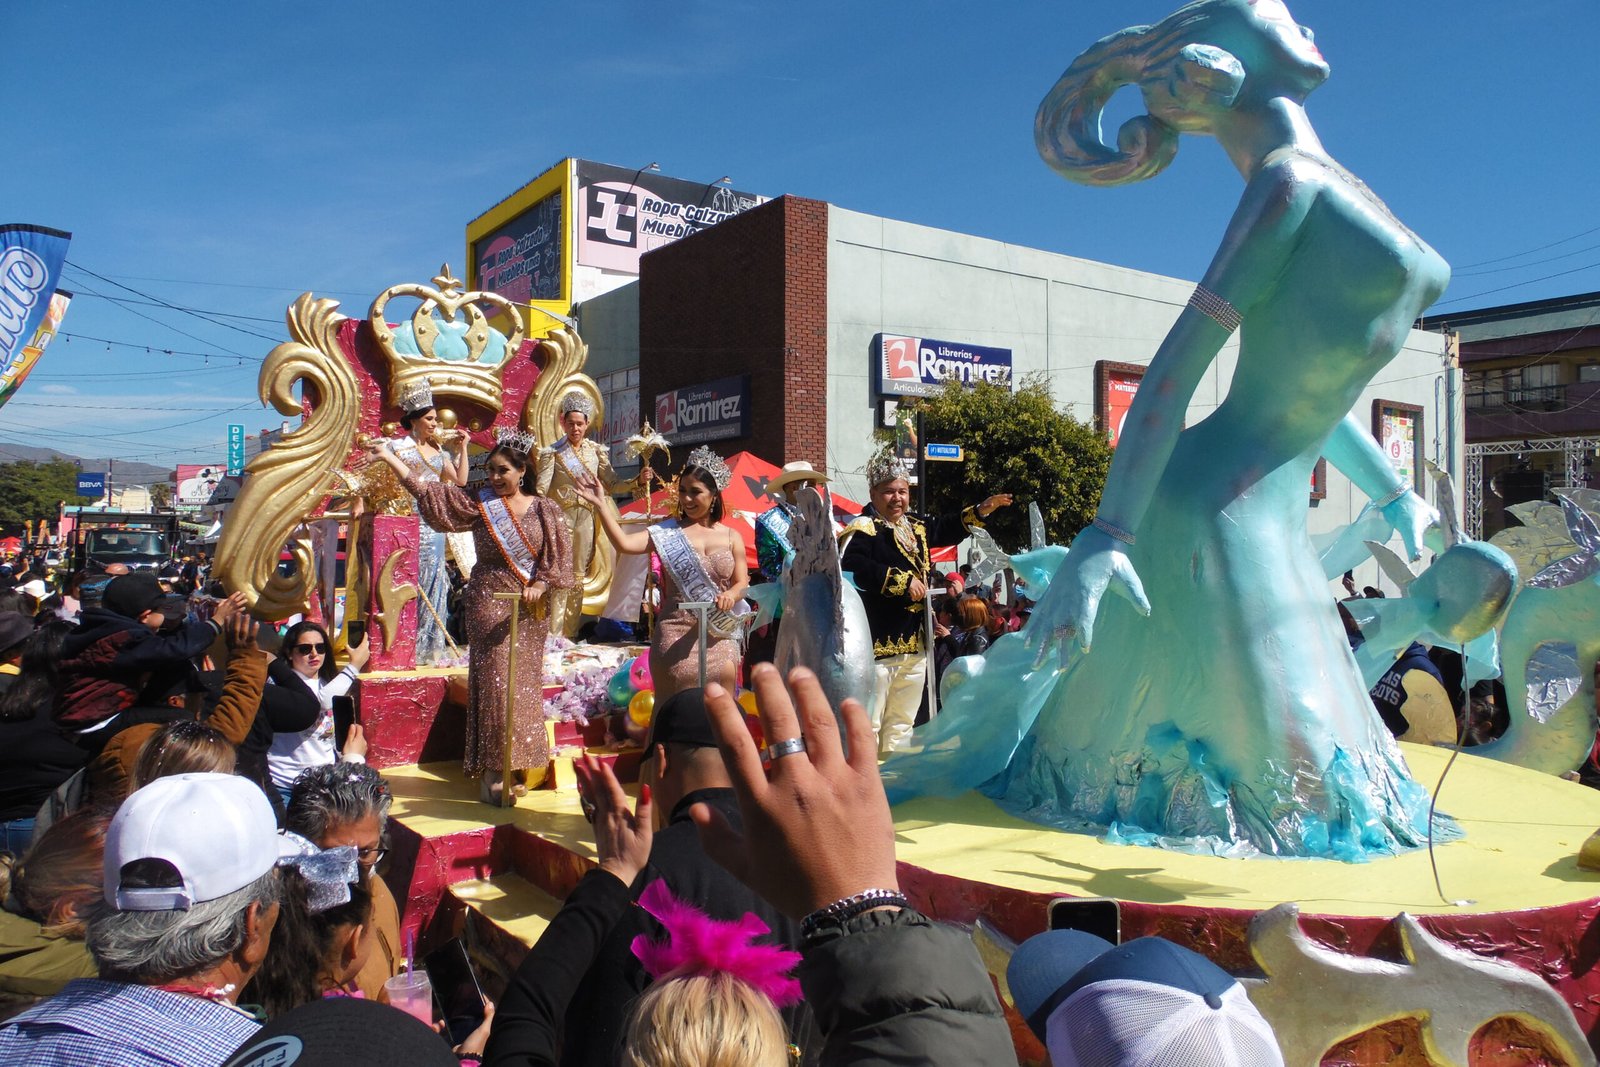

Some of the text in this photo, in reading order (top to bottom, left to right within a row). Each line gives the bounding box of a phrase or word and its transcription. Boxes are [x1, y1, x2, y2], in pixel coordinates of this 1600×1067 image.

[642, 198, 680, 217] Ropa
[920, 347, 1012, 386] Ramírez
[938, 346, 973, 359] Librerías
[677, 392, 741, 428] Ramírez
[231, 426, 241, 475] DEVLYN
[79, 481, 102, 489] BBVA
[662, 539, 700, 587] PRINCESA
